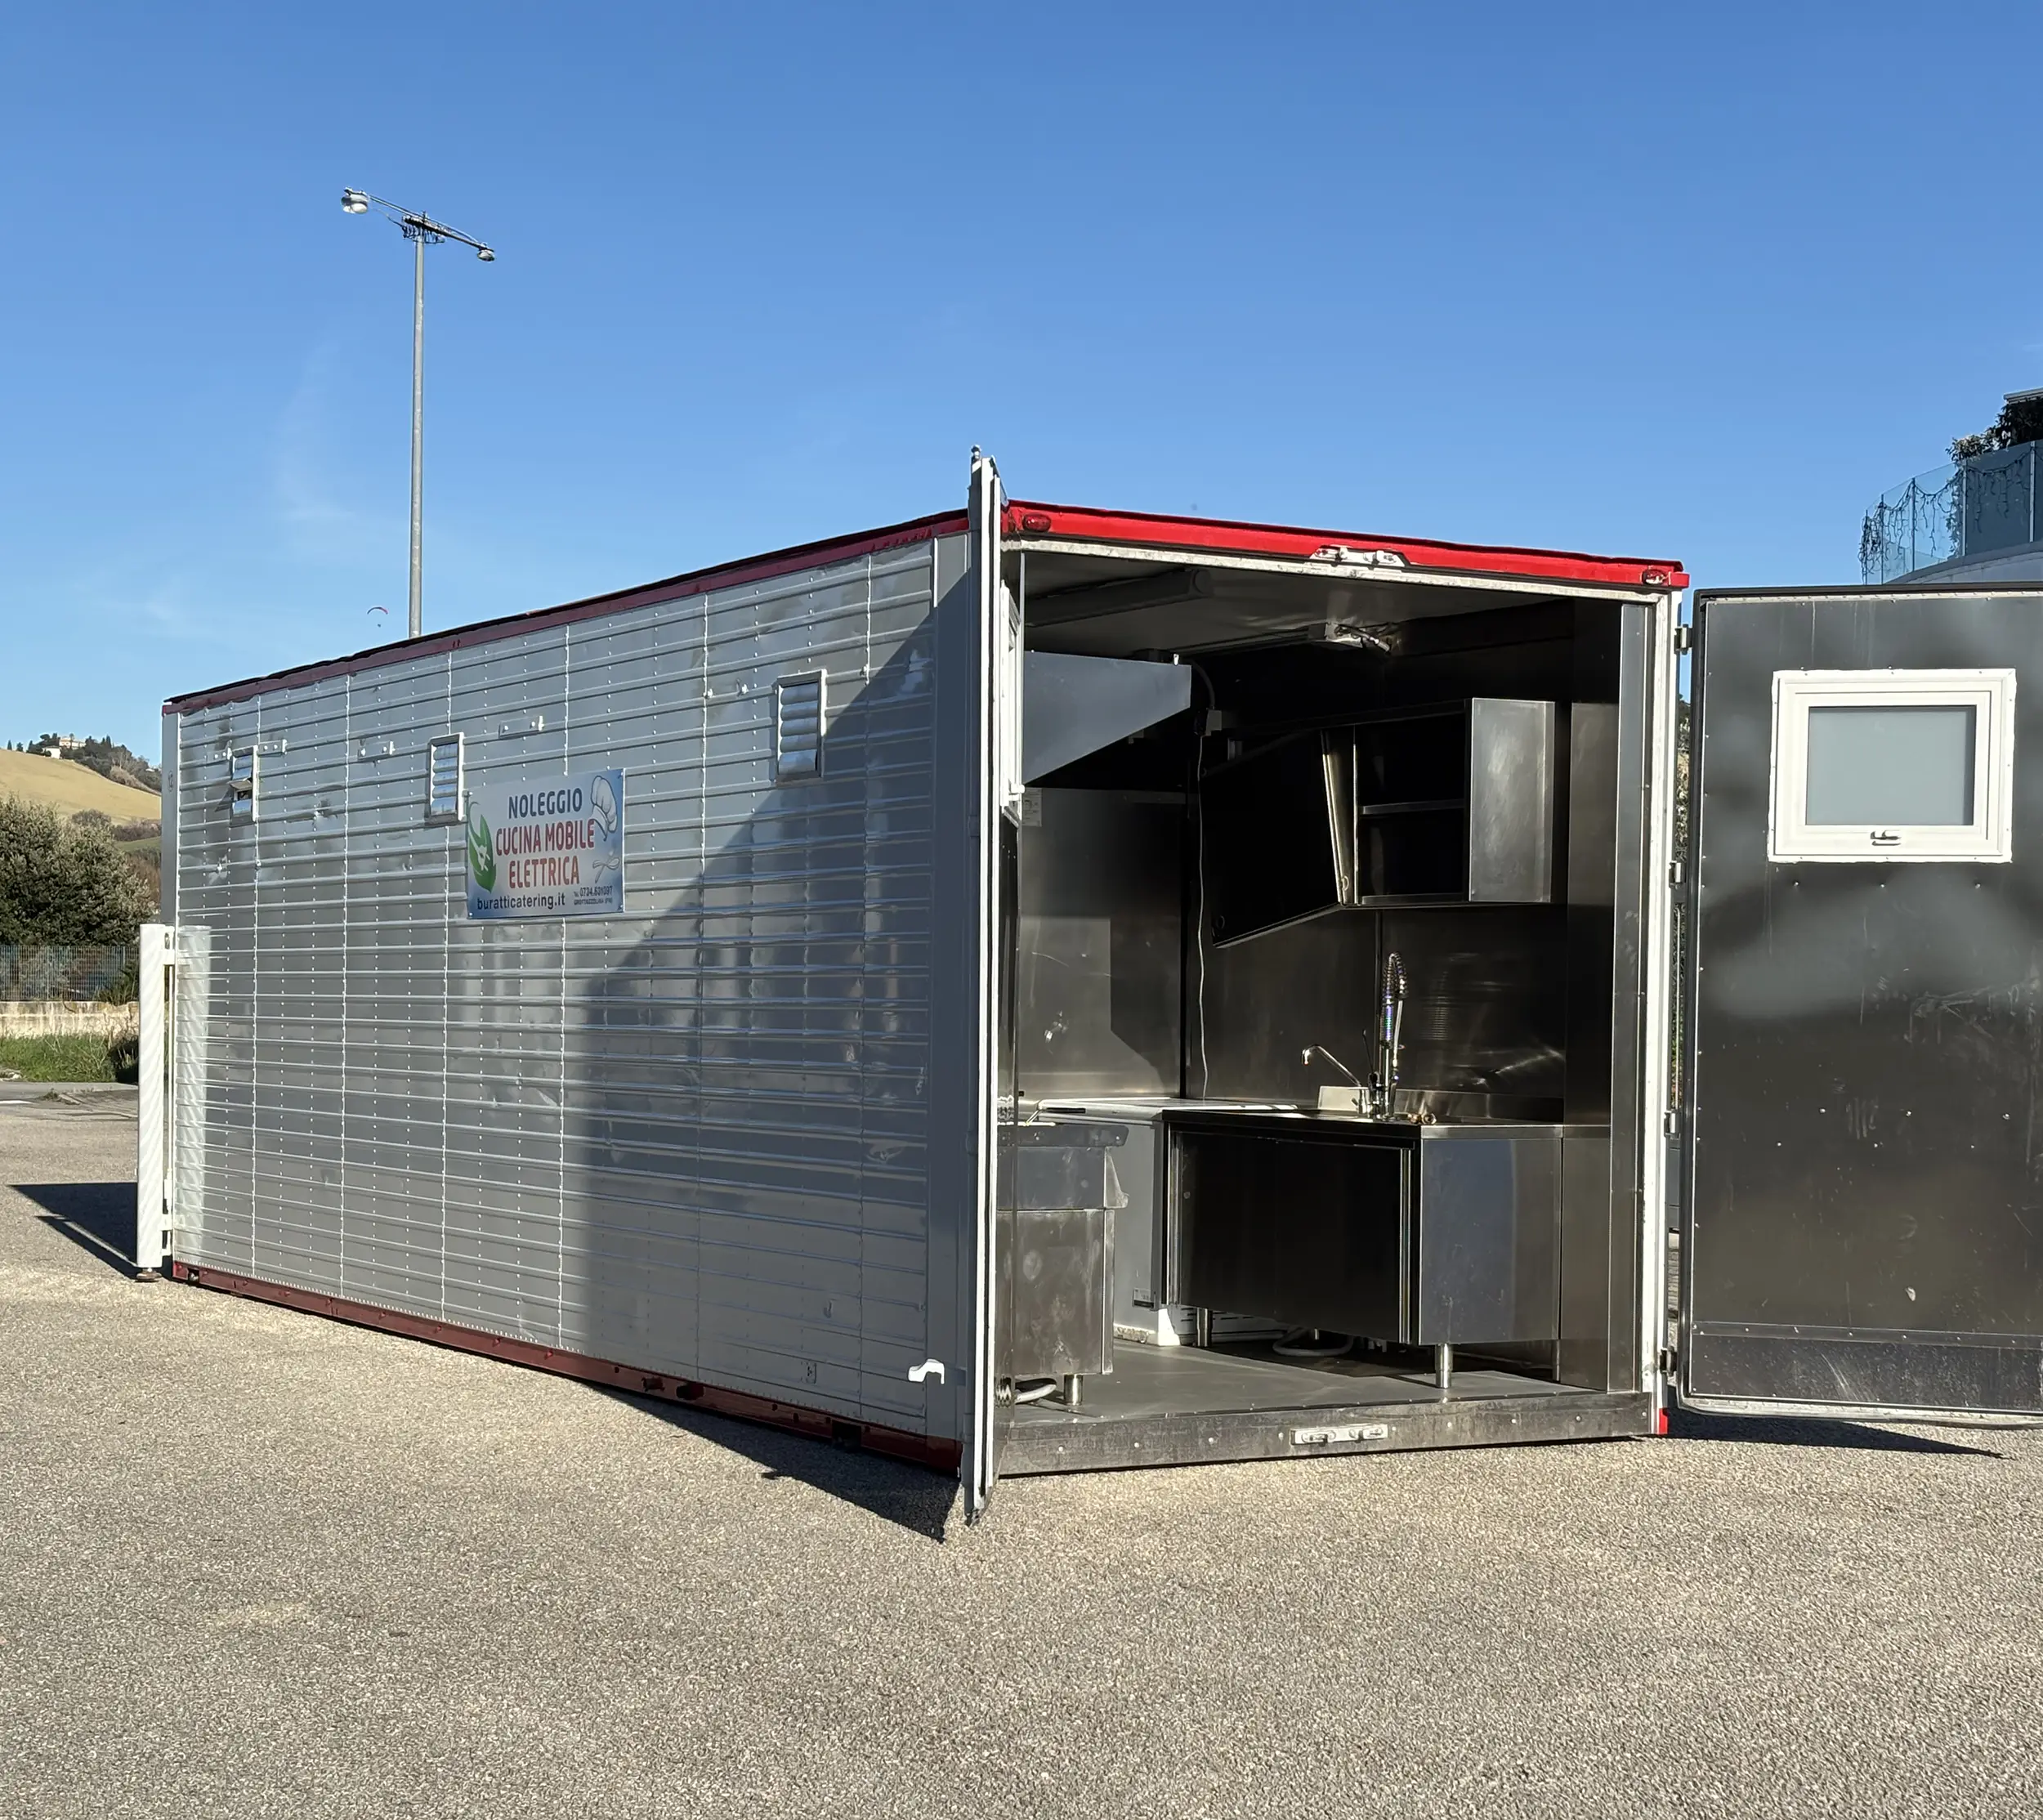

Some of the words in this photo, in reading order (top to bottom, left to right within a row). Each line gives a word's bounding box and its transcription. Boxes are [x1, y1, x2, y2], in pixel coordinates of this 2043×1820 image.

[508, 788, 583, 819] NOLEGGIO
[496, 824, 541, 856] CUCINA
[545, 819, 595, 852] MOBILE
[509, 856, 580, 888] ELETTRICA
[477, 892, 566, 910] buratticatering.it
